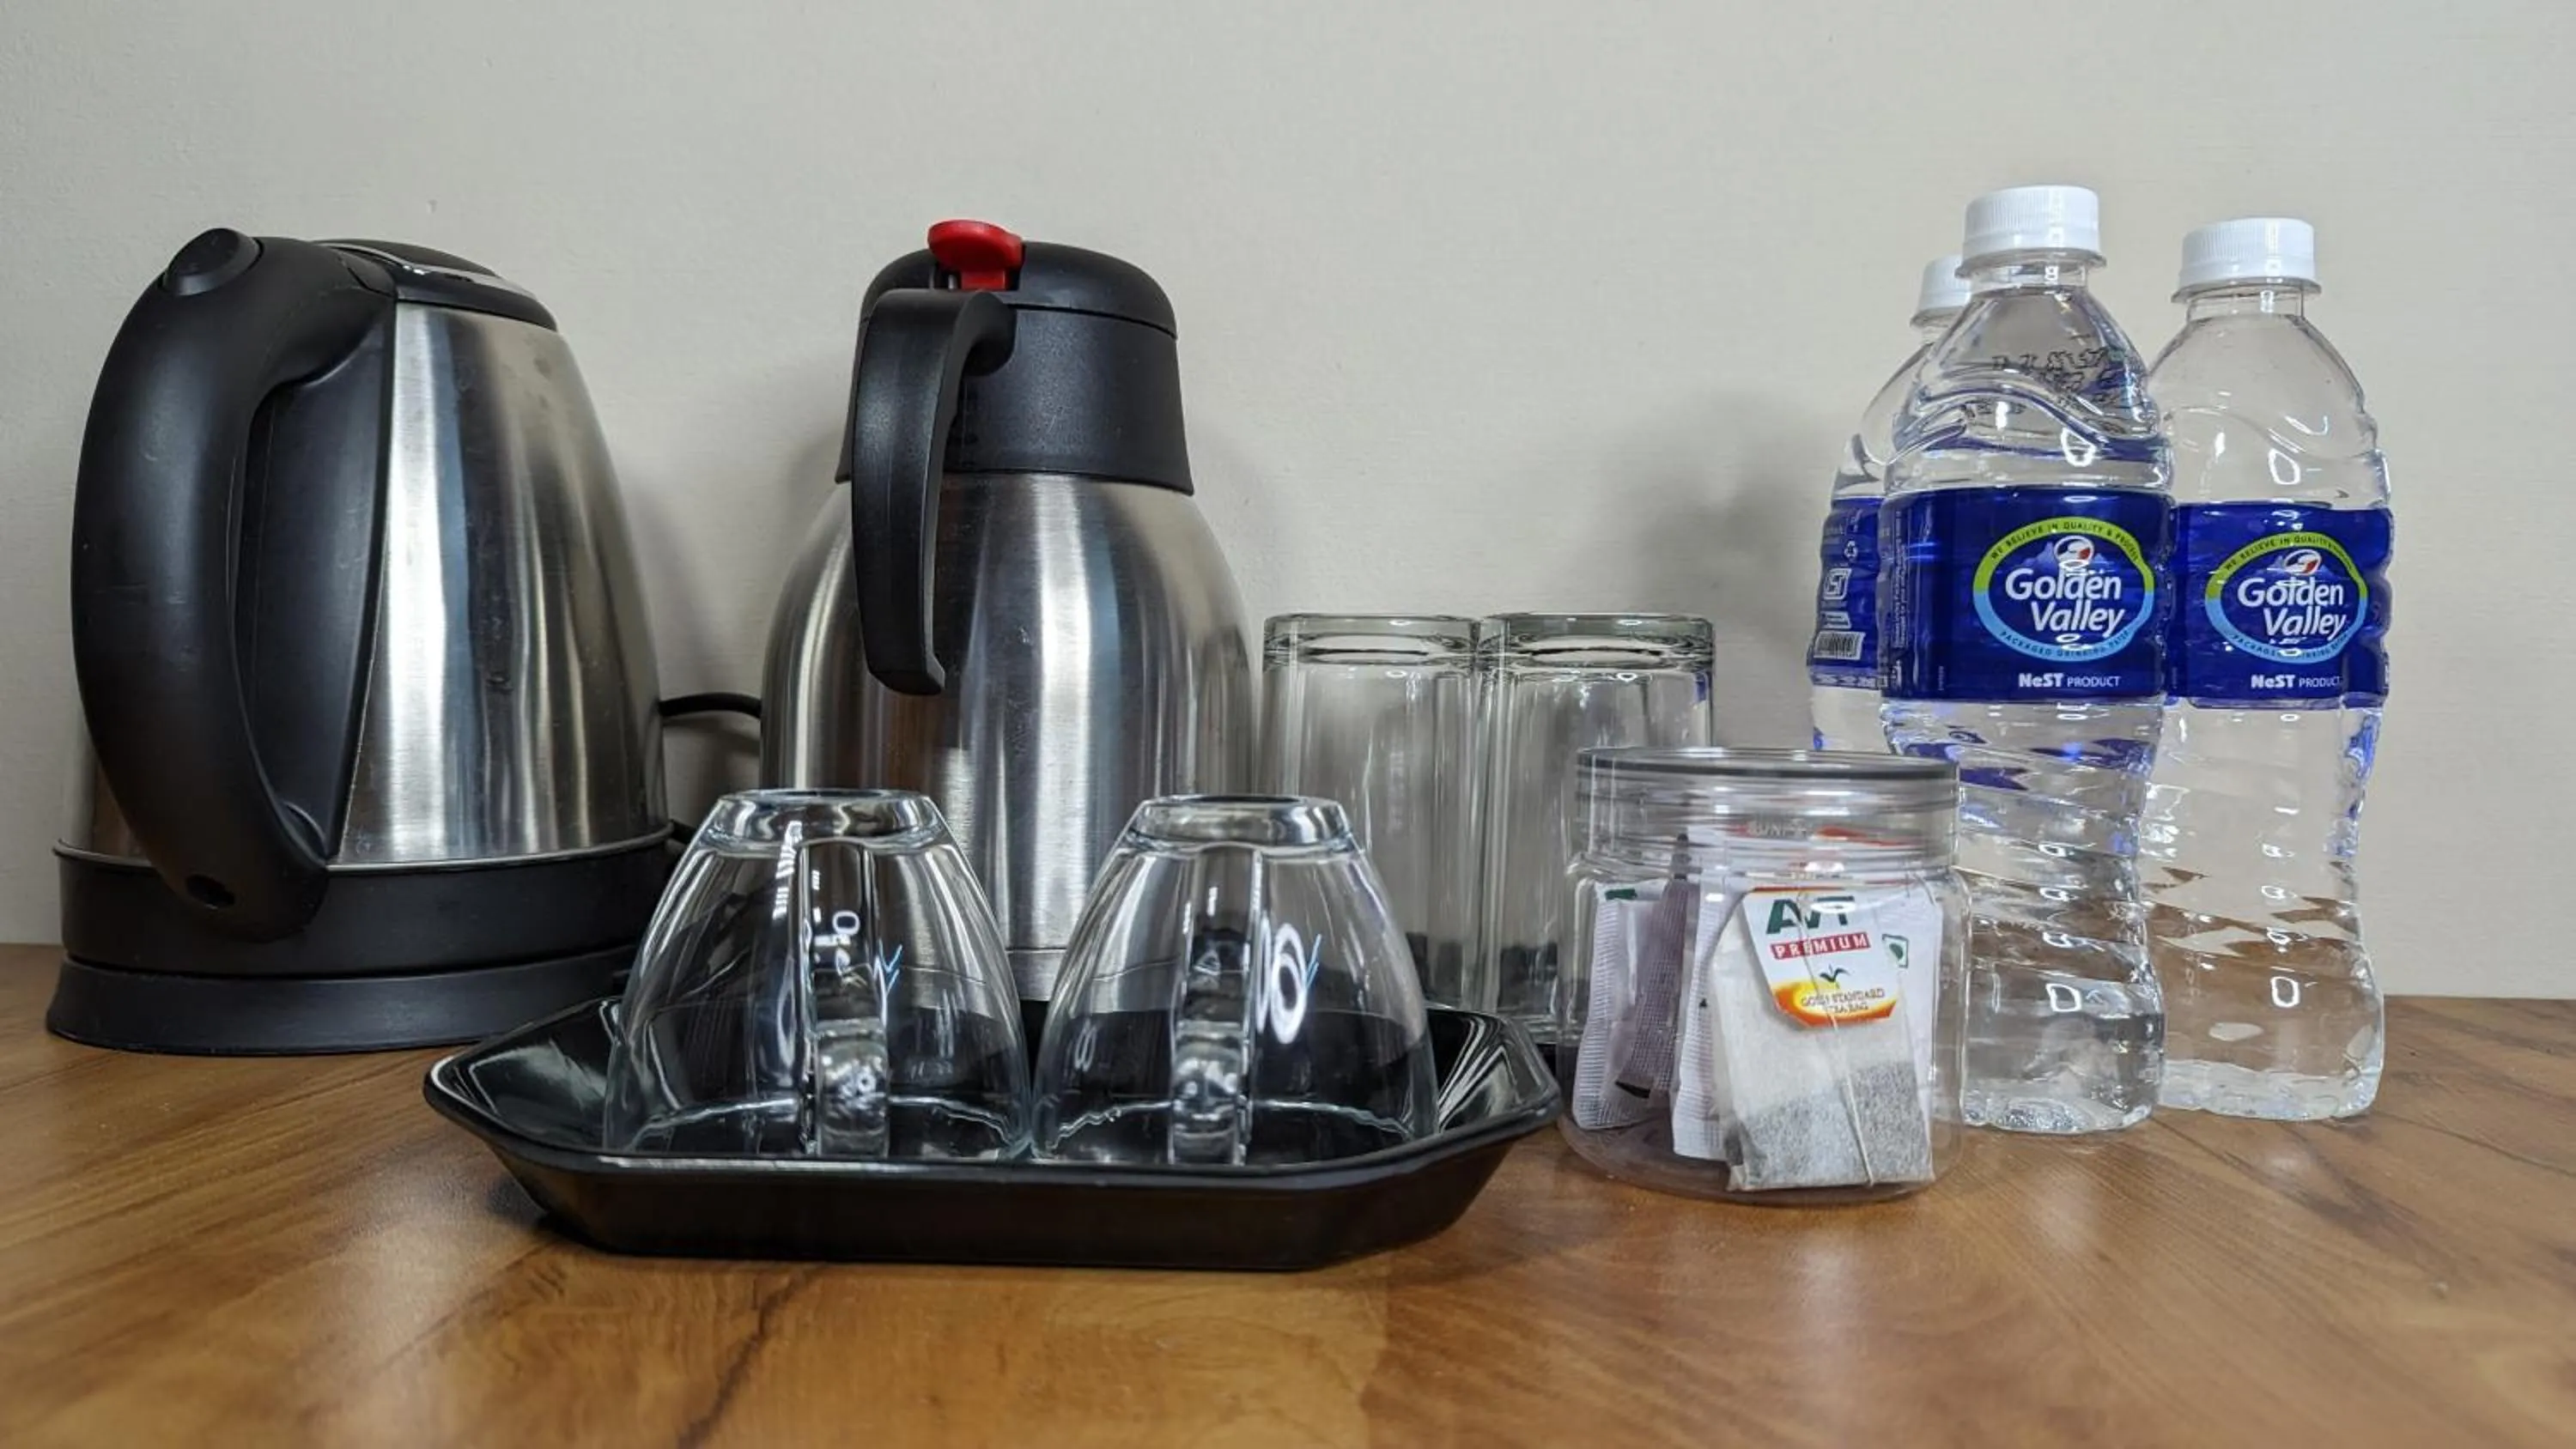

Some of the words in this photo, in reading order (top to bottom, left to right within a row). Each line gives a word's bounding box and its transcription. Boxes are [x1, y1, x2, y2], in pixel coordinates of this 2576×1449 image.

[2007, 524, 2044, 548] BELIEVE
[2046, 522, 2059, 531] IN
[2063, 521, 2104, 533] QUALITY
[2239, 539, 2275, 559] BELIEVE
[2279, 537, 2291, 545] IN
[2005, 566, 2123, 601] Golden
[2237, 577, 2344, 608] Golden
[2030, 597, 2126, 638] Valley
[2263, 606, 2347, 642] Valley
[1999, 630, 2052, 657] PACKAGED
[2019, 672, 2065, 688] NeST
[2067, 676, 2122, 688] PRODUCT
[2250, 674, 2296, 688] NeST
[2299, 676, 2342, 688] PRODUCT
[1775, 933, 1868, 958] PREMIUM
